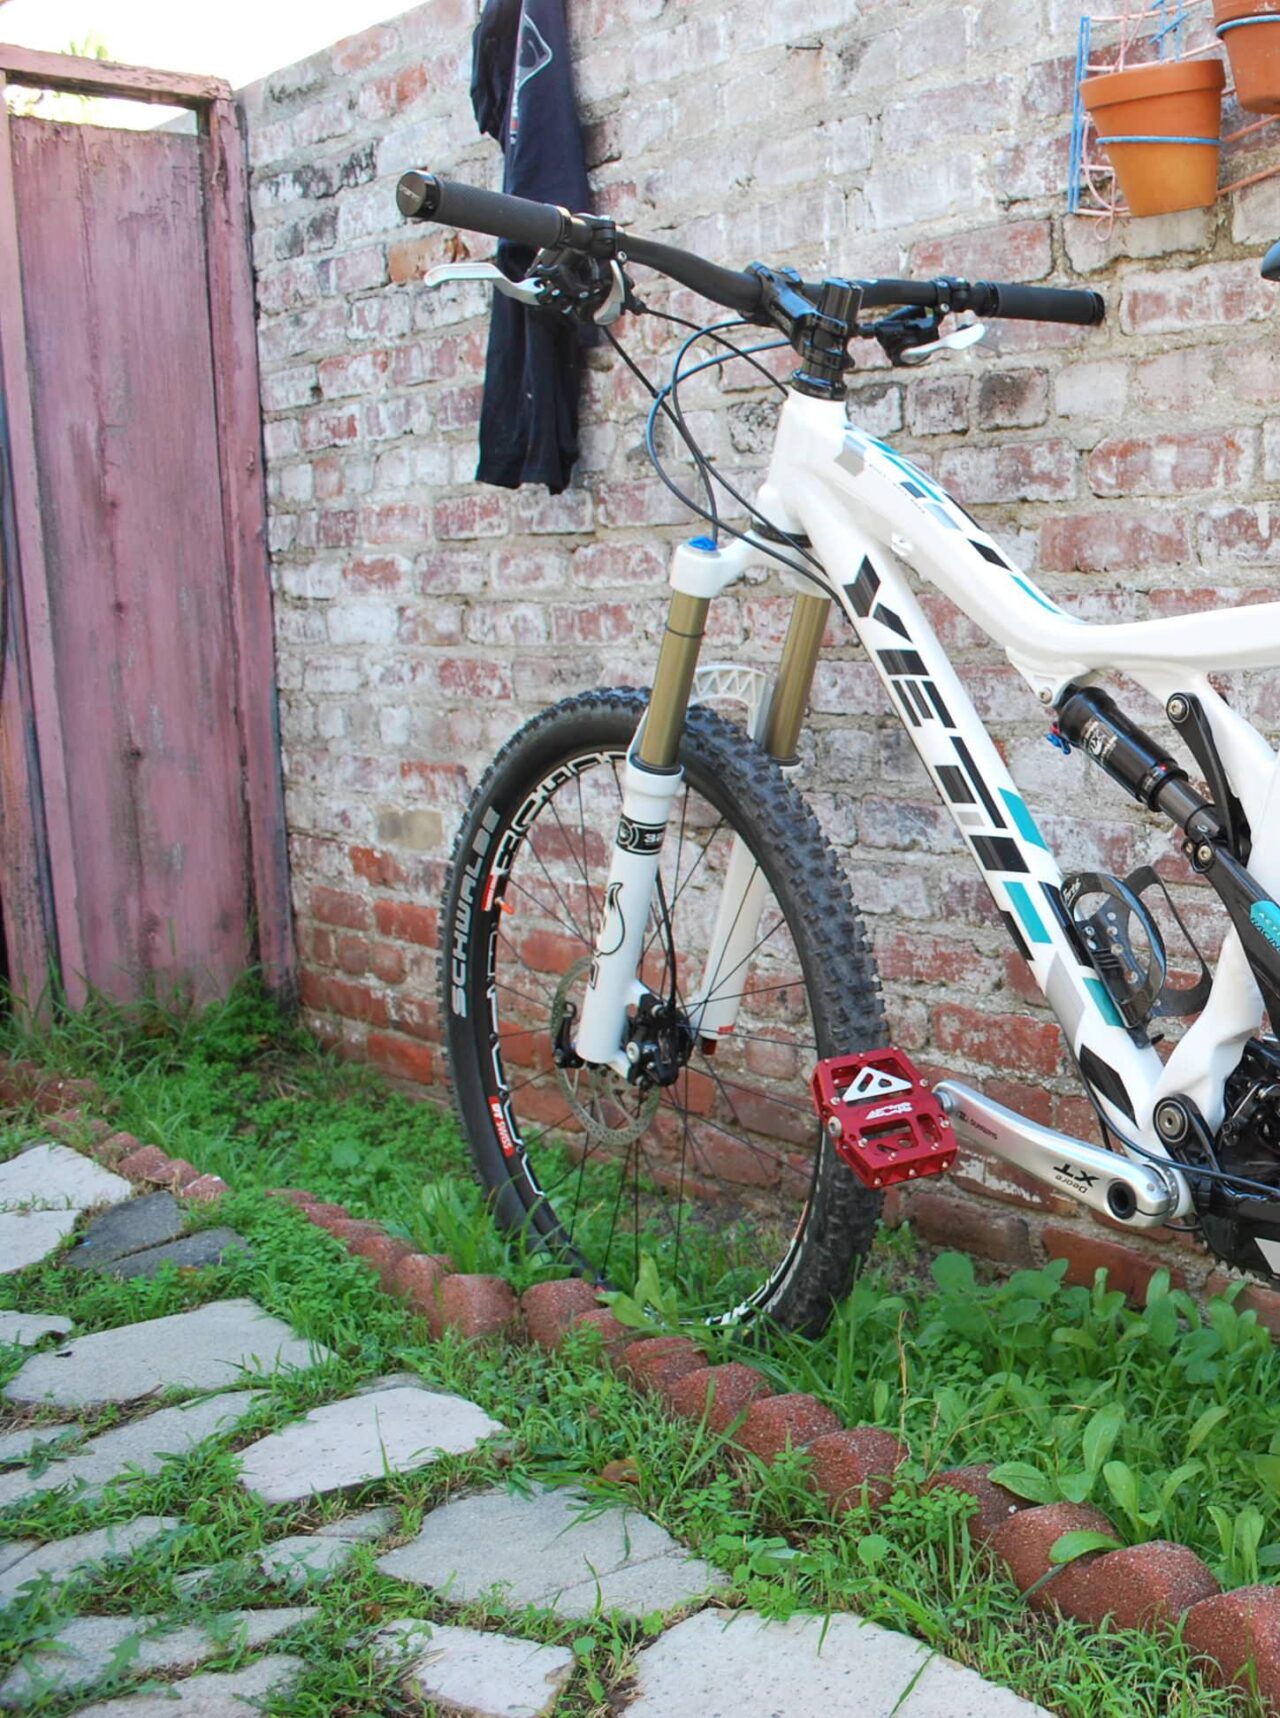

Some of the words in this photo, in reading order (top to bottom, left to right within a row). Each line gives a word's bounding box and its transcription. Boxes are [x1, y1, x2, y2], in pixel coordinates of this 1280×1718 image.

[843, 553, 1030, 874] YETI
[452, 805, 501, 1019] SCHWALBE
[490, 1102, 504, 1119] DT
[496, 1119, 513, 1150] SWISS
[1052, 1162, 1100, 1188] XT
[1055, 1174, 1088, 1194] Deore
